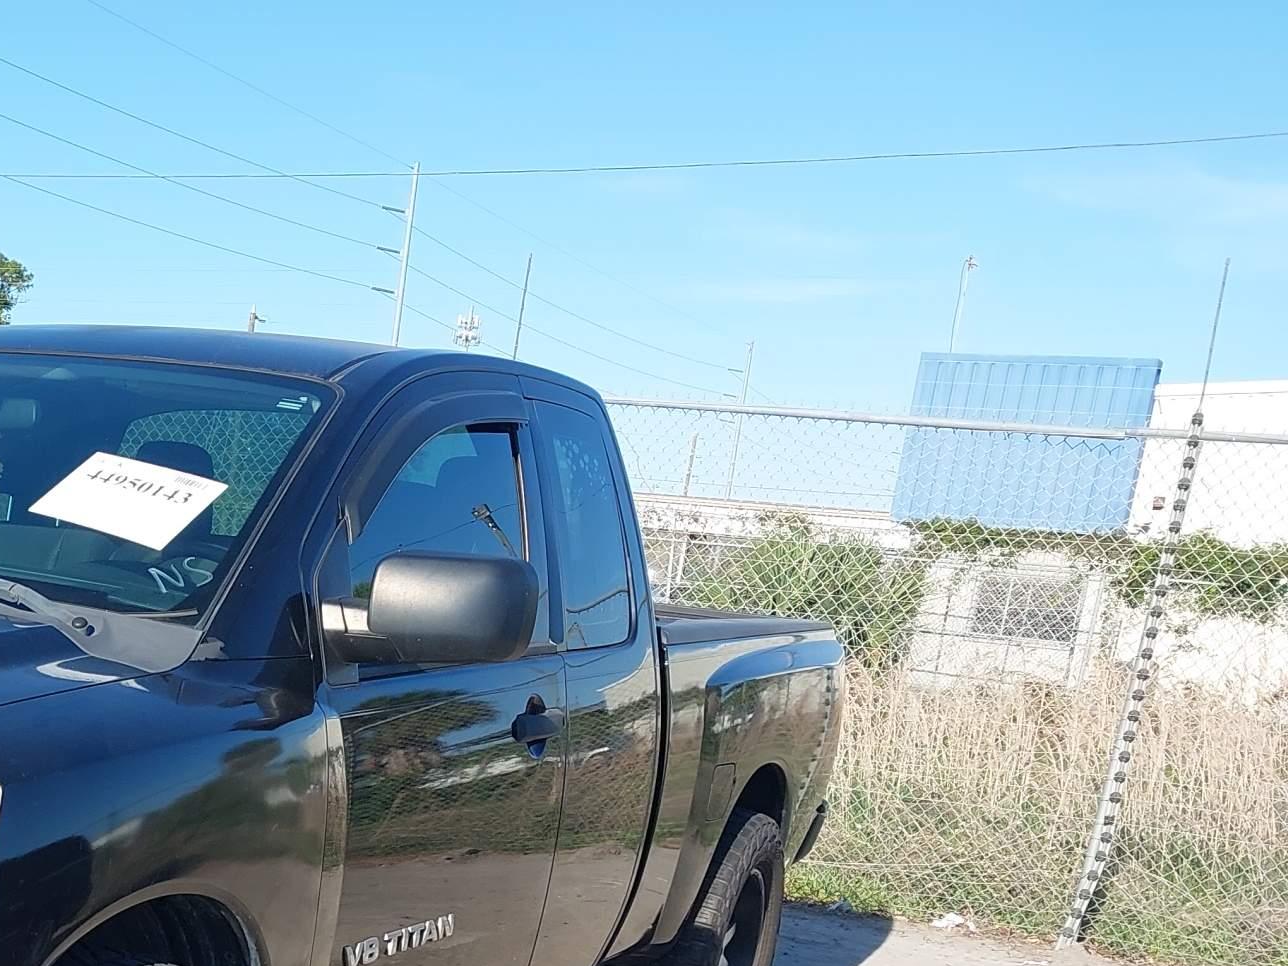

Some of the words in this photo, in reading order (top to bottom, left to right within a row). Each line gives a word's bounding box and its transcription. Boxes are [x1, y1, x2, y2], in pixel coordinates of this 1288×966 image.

[87, 470, 193, 504] 44950143
[148, 556, 214, 593] NS
[384, 913, 456, 956] TITAN
